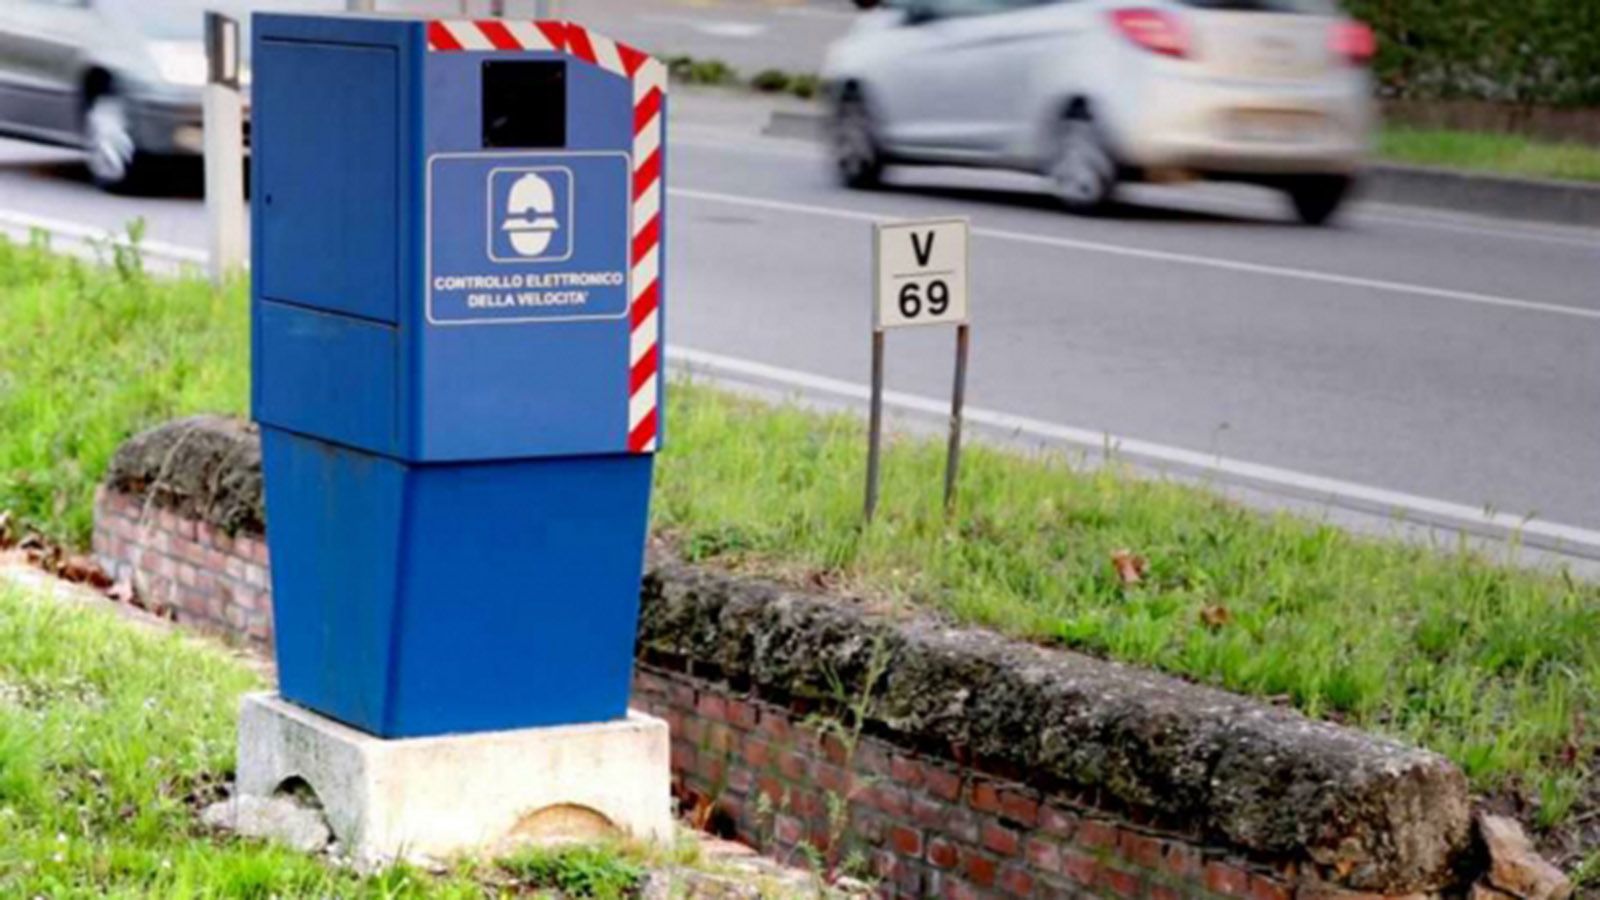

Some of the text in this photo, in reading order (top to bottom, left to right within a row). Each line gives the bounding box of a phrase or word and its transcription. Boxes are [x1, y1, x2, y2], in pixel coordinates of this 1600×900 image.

[910, 230, 936, 267] V
[434, 271, 624, 290] CONTROLLO ELETTRONICO
[467, 292, 515, 308] DELLA
[898, 279, 950, 319] 69
